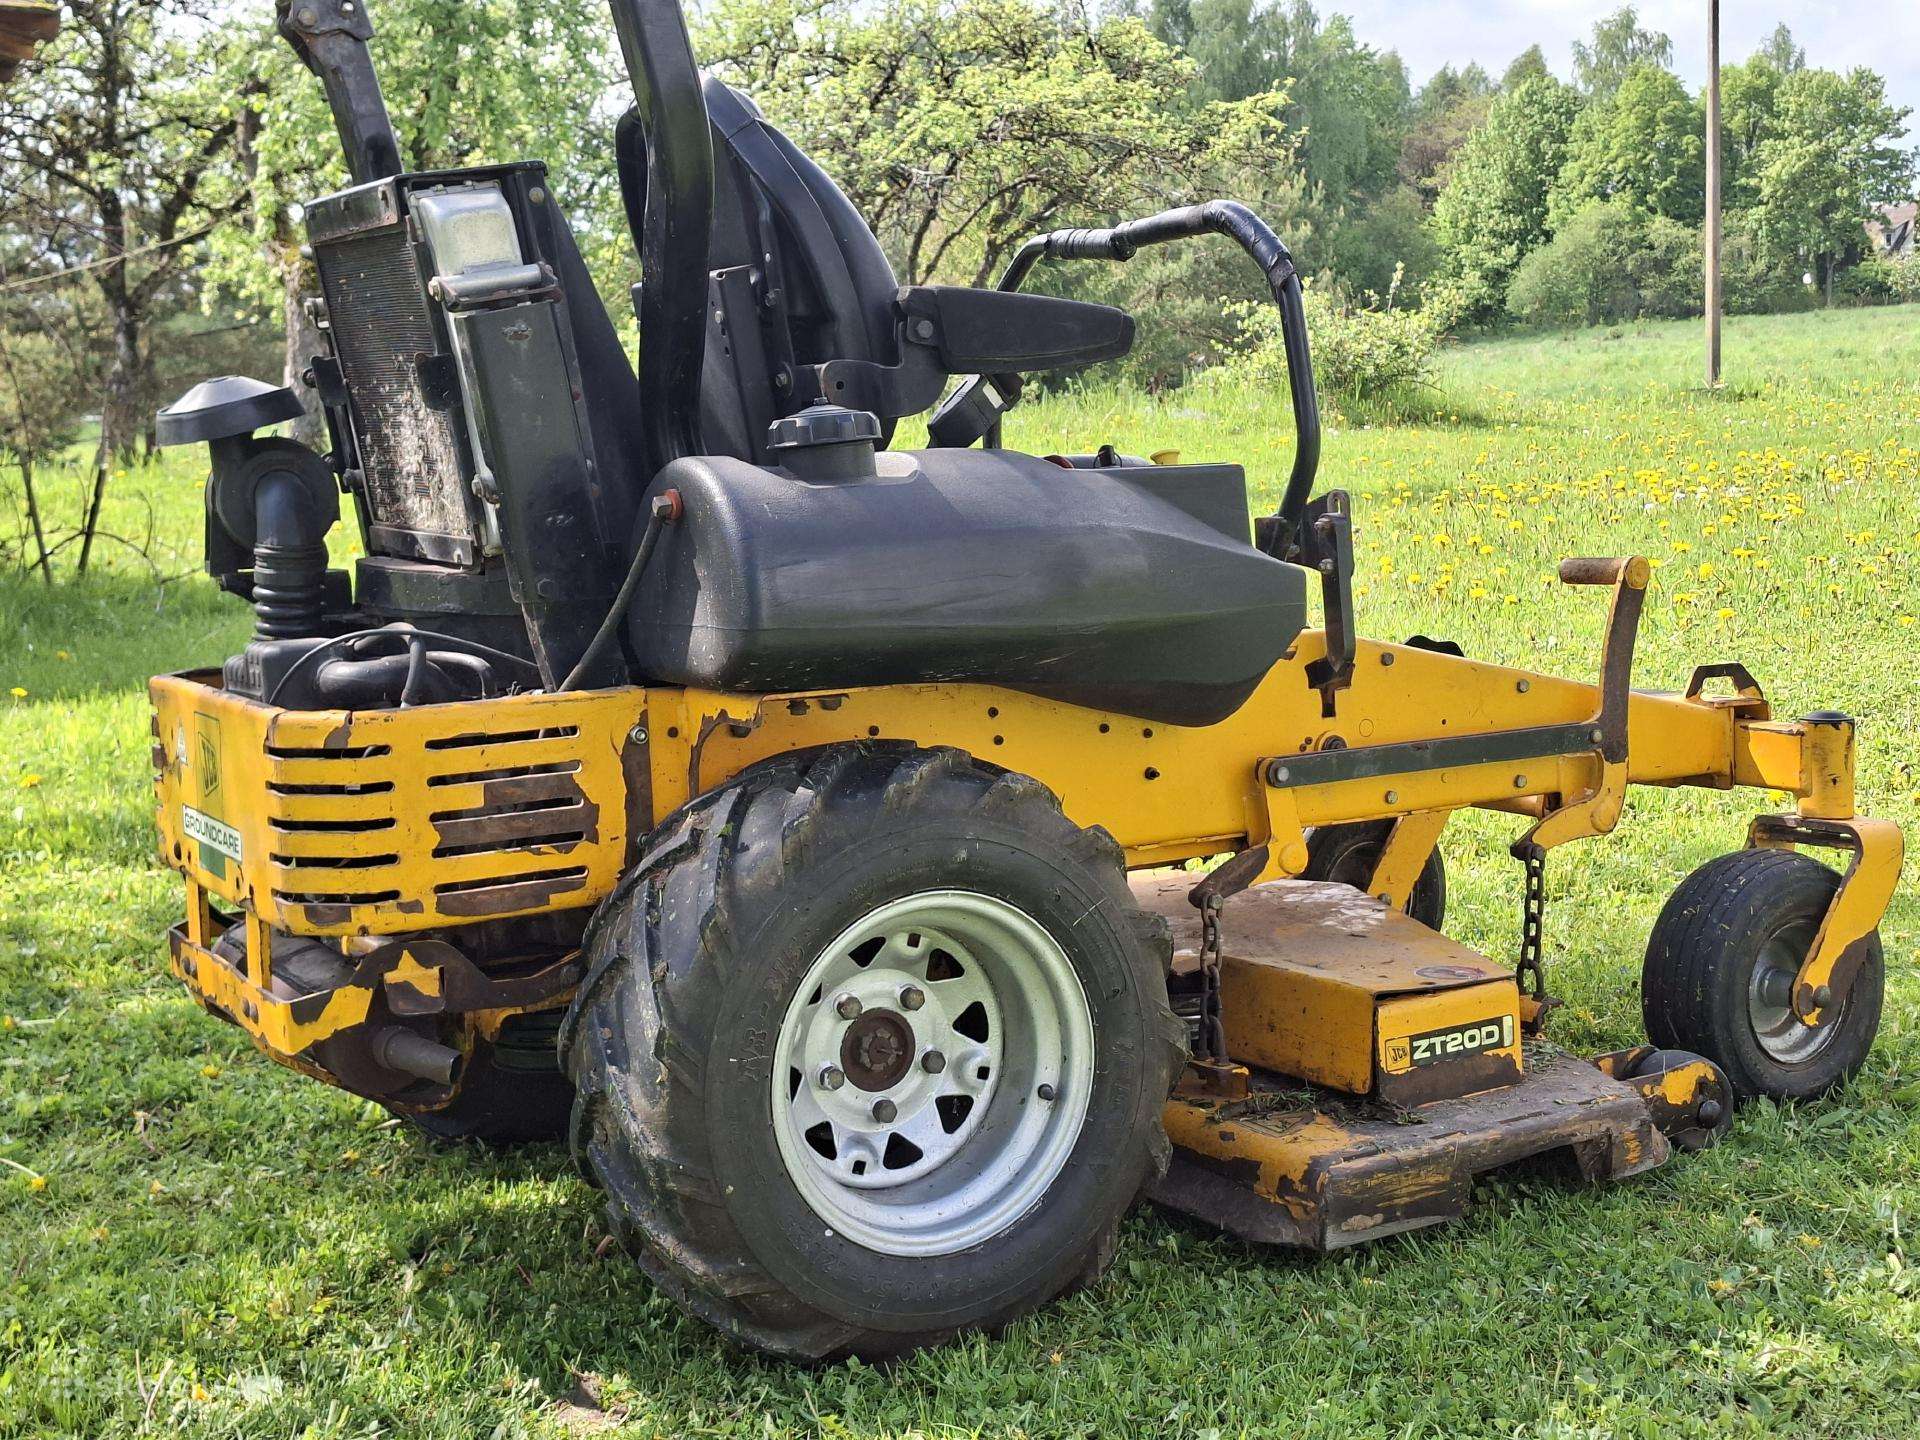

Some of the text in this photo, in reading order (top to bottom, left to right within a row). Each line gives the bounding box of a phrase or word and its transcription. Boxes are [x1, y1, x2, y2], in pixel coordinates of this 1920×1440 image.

[184, 811, 240, 854] GROUNDCARE
[1391, 1046, 1408, 1063] JCB
[1412, 1024, 1500, 1060] ZT20D
